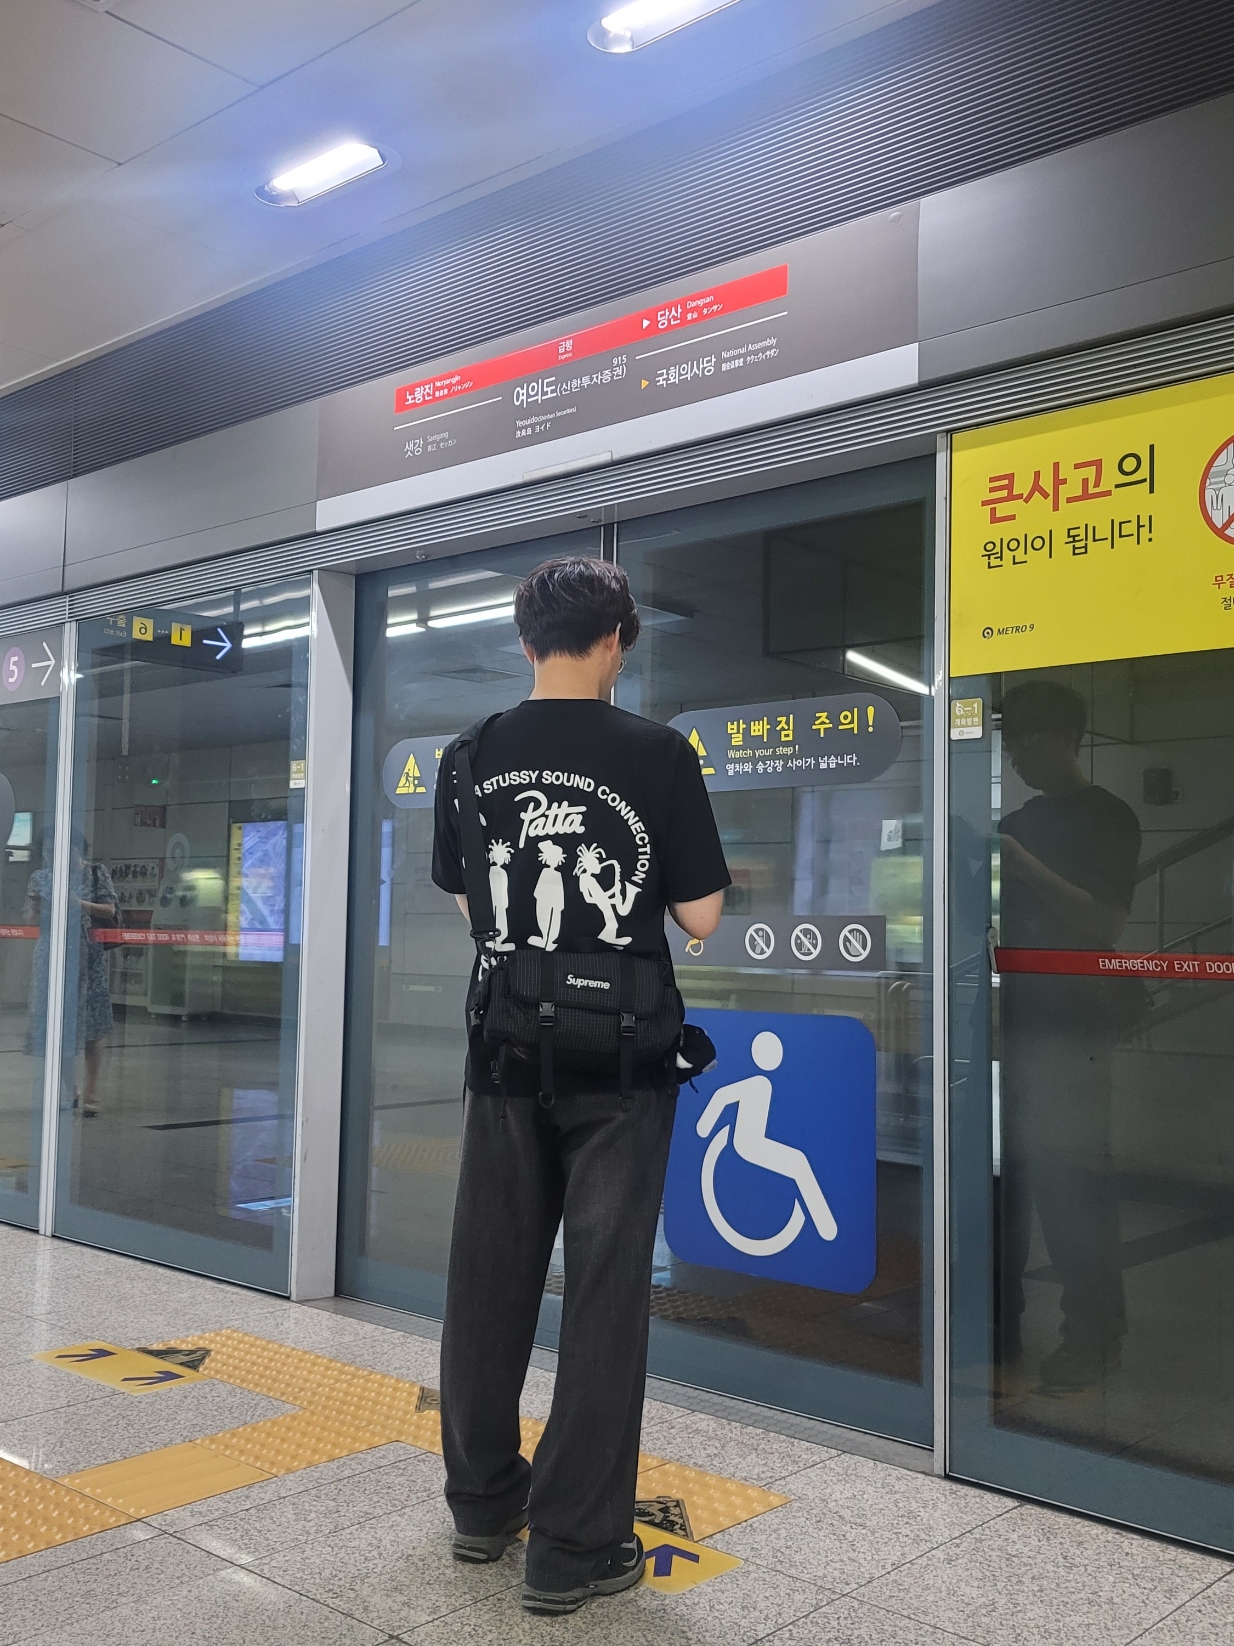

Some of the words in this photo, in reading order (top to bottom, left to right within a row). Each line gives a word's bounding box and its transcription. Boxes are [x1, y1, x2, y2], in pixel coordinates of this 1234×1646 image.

[687, 296, 714, 308] Dangsan
[657, 304, 682, 328] 당산
[721, 344, 747, 359] National
[748, 336, 778, 354] Assembly
[612, 354, 626, 366] 915
[655, 354, 716, 387] 국회의사당
[404, 382, 433, 404] 노량진
[534, 422, 552, 432] ヨイド
[404, 438, 424, 458] 샛강
[980, 444, 1155, 524] 큰사고의
[981, 529, 1052, 570] 원인이
[1064, 514, 1152, 556] 됩니다!
[1220, 596, 1234, 610] 절
[996, 624, 1027, 636] METRO
[1029, 624, 1034, 632] 9
[8, 656, 18, 683] 5
[727, 714, 794, 746] 발빠짐
[728, 748, 752, 758] Watch
[754, 749, 774, 758] your
[726, 762, 752, 776] 열차와
[756, 760, 784, 774] 승강장
[786, 757, 816, 770] 사이가
[818, 753, 860, 768] 넓습니다.
[483, 770, 540, 794] STUSSY
[542, 770, 595, 792] SOUND
[597, 786, 650, 884] CONNECTION
[514, 790, 587, 849] Patta
[1098, 958, 1168, 971] EMERGENCY
[1174, 960, 1200, 972] EXIT
[566, 974, 610, 989] Supreme
